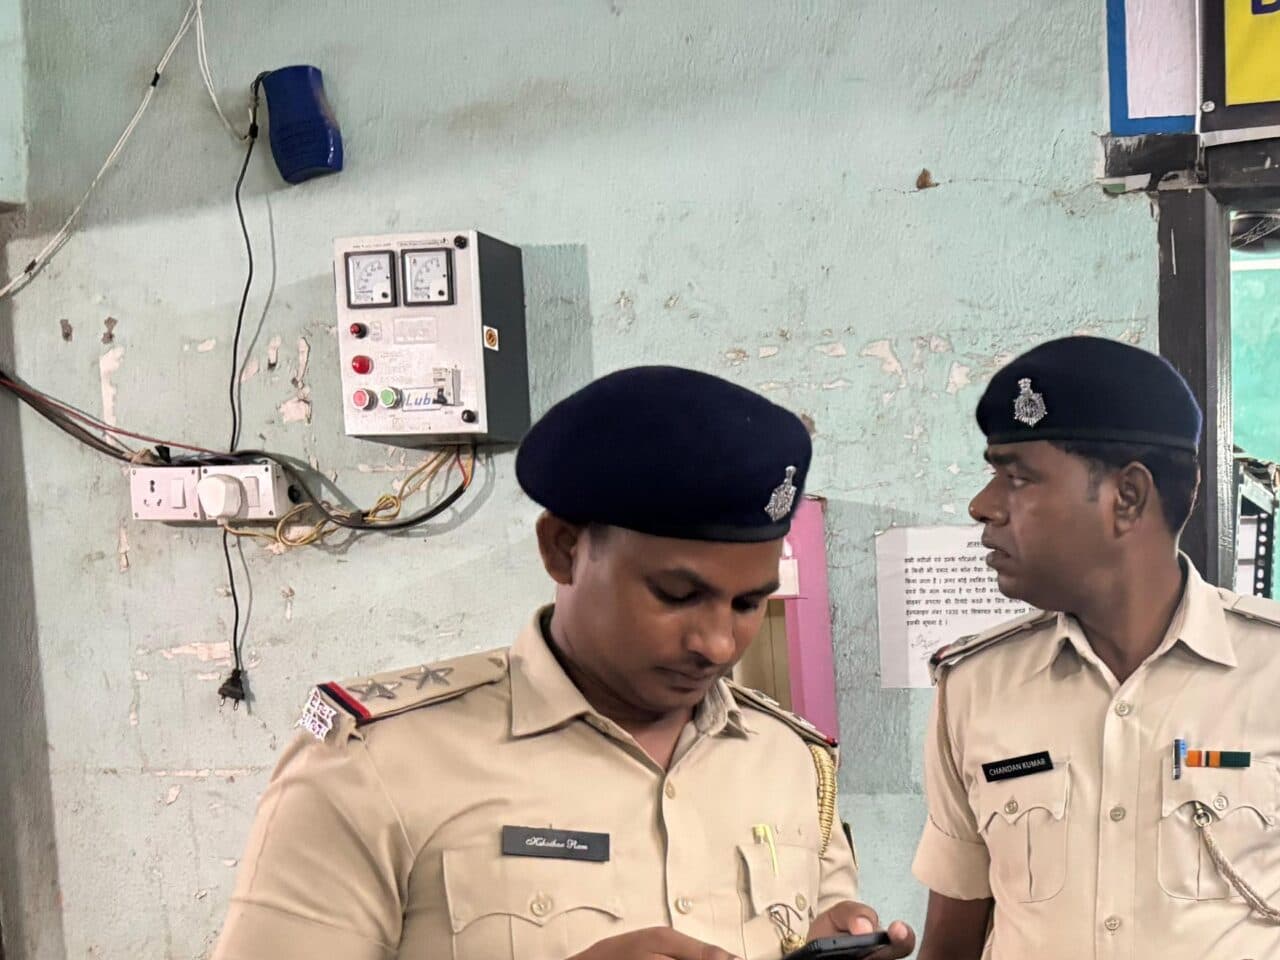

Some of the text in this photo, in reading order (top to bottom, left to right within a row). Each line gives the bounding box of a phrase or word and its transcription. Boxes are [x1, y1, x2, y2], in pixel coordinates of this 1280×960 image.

[406, 393, 431, 406] Lub
[989, 758, 1046, 776] CHANDAN KUMAR
